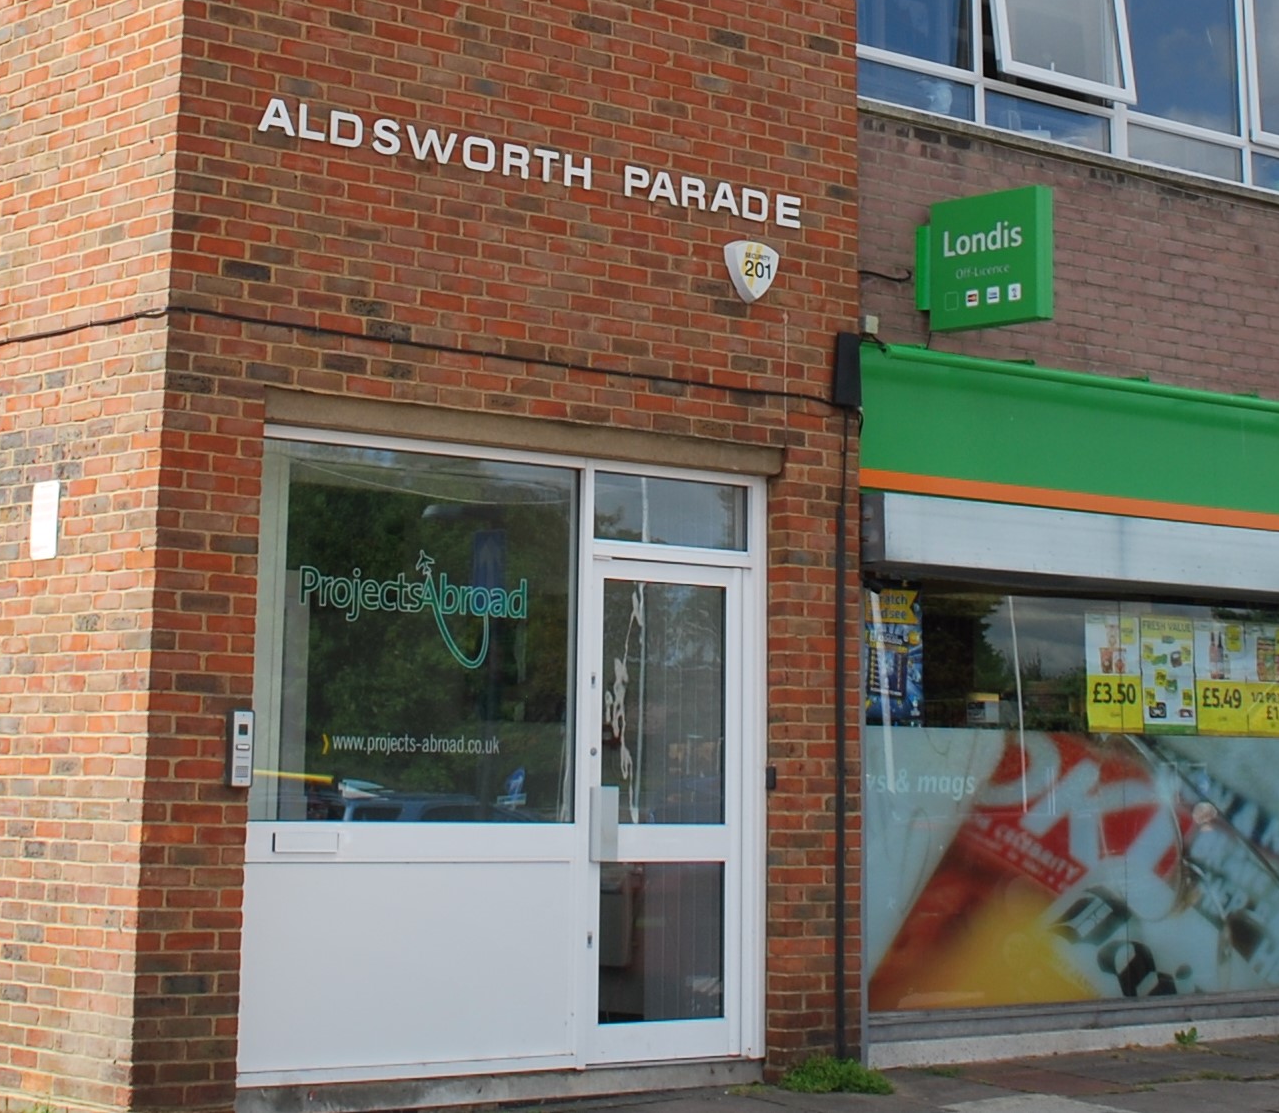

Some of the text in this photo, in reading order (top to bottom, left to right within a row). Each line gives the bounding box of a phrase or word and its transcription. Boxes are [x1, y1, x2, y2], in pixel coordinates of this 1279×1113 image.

[258, 97, 802, 229] ALDSWORTH PARADE
[943, 220, 1023, 258] Londis
[744, 260, 771, 280] 201
[1093, 682, 1136, 704] £3.50
[1202, 687, 1242, 709] £5.49
[332, 733, 501, 755] www.projects-abroad.co.uk
[895, 769, 910, 794] &
[917, 774, 976, 800] mags
